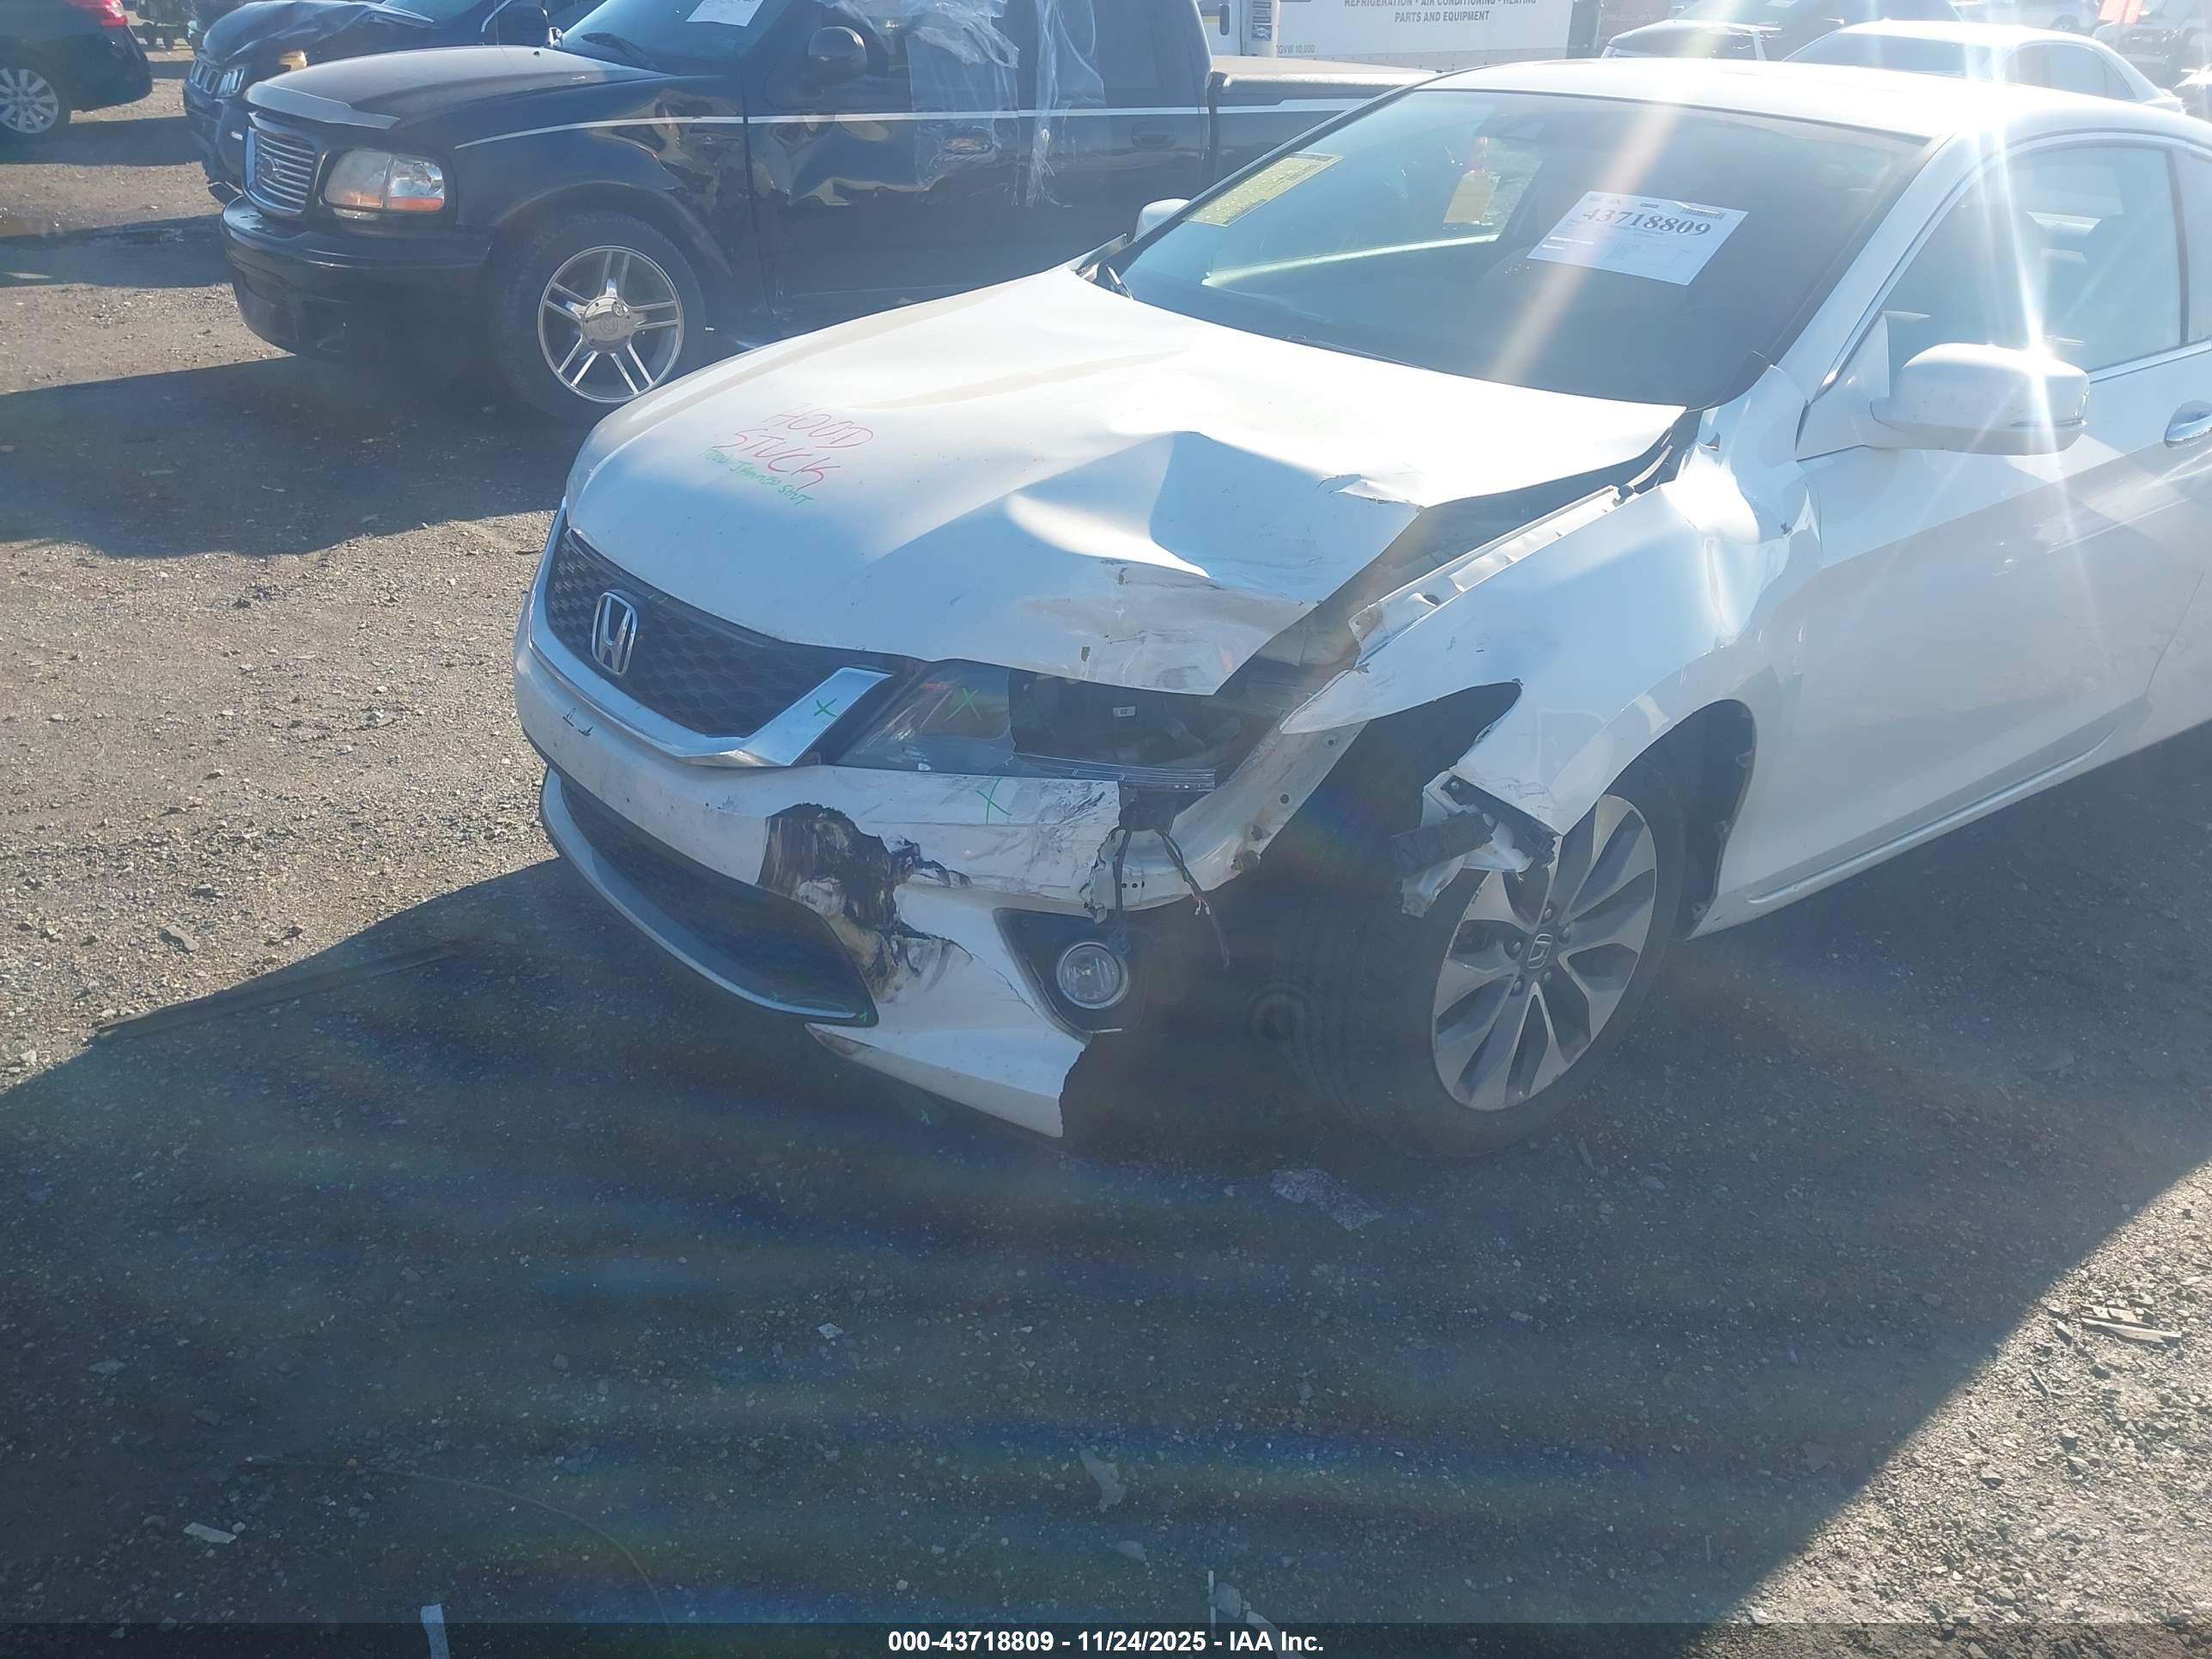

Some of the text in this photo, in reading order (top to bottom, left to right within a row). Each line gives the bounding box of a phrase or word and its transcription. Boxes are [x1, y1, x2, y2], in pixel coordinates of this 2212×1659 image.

[1395, 10, 1491, 22] PARTS AND EQUIPMENT
[1583, 208, 1712, 235] 43718809
